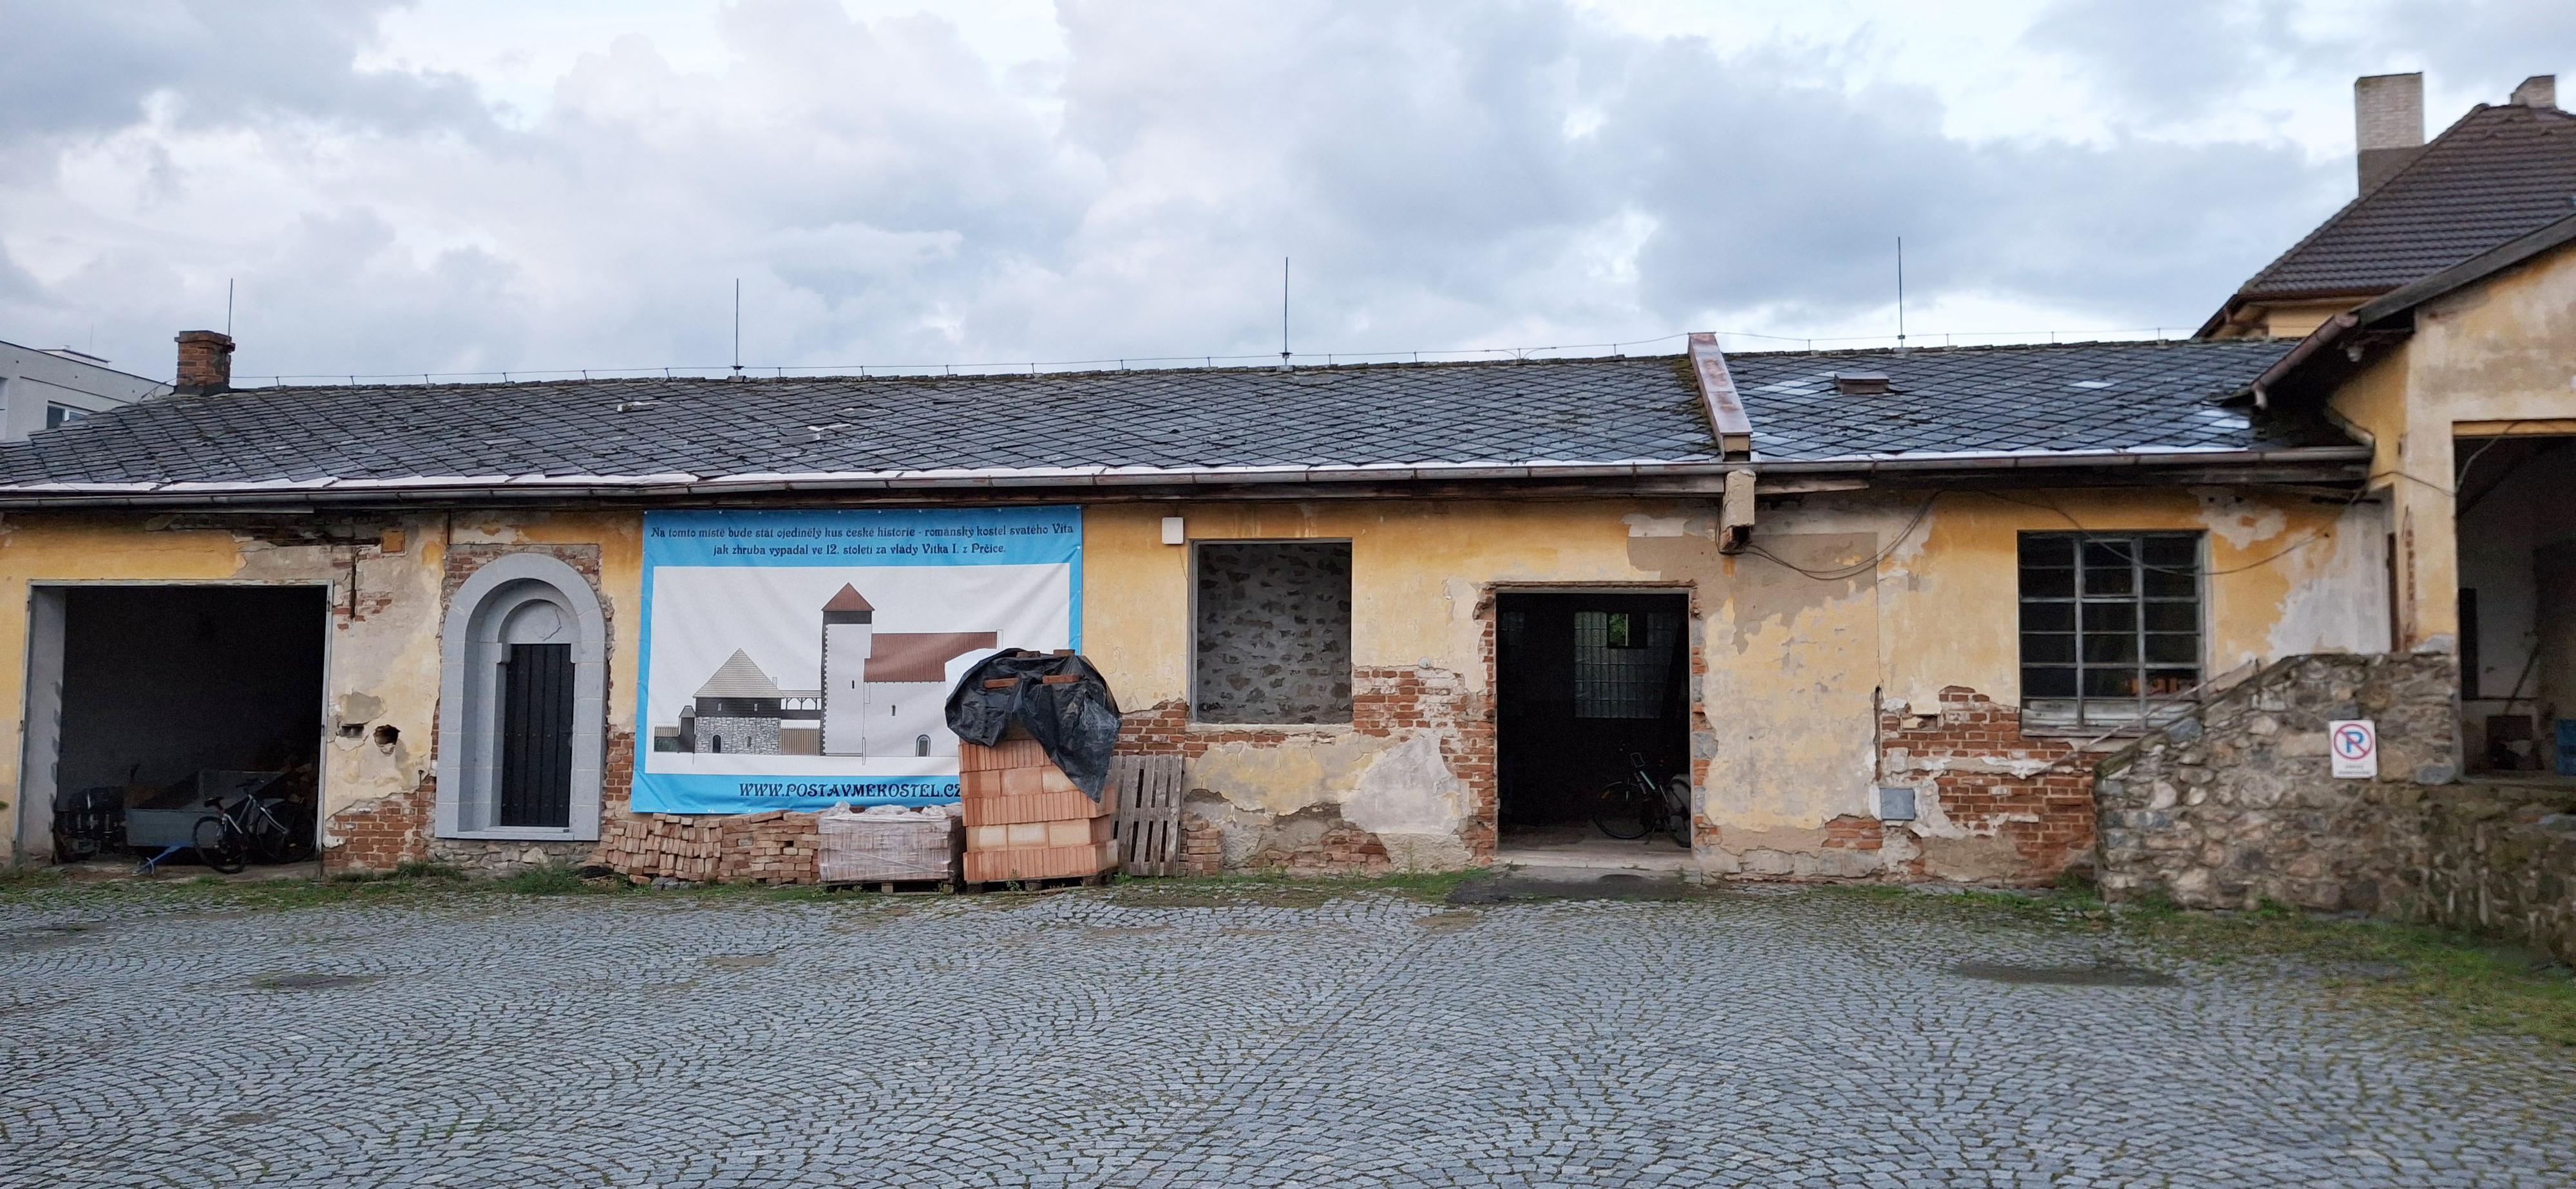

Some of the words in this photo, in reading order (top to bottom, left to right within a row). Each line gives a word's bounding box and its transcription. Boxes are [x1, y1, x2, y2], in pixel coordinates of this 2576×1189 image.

[650, 527, 666, 538] Na
[668, 528, 696, 538] tomto
[699, 527, 725, 538] místě
[728, 526, 752, 538] bude
[755, 527, 773, 538] stát
[777, 526, 822, 539] ojedinělý
[825, 527, 842, 538] kus
[846, 525, 875, 538] české
[877, 527, 915, 538] historie
[925, 525, 974, 538] románský
[976, 525, 1007, 536] kostel
[1010, 524, 1048, 536] svatého
[714, 545, 729, 556] jak
[732, 544, 766, 555] zhruba
[769, 545, 808, 557] vypadal
[812, 547, 823, 555] ve
[826, 545, 840, 555] 12.
[876, 546, 887, 554] za
[890, 544, 918, 556] vlády
[952, 543, 960, 554] I.
[971, 543, 1006, 554] Prčice.
[739, 782, 961, 798] WWW.POSTAVMEKOSTEL.CZ
